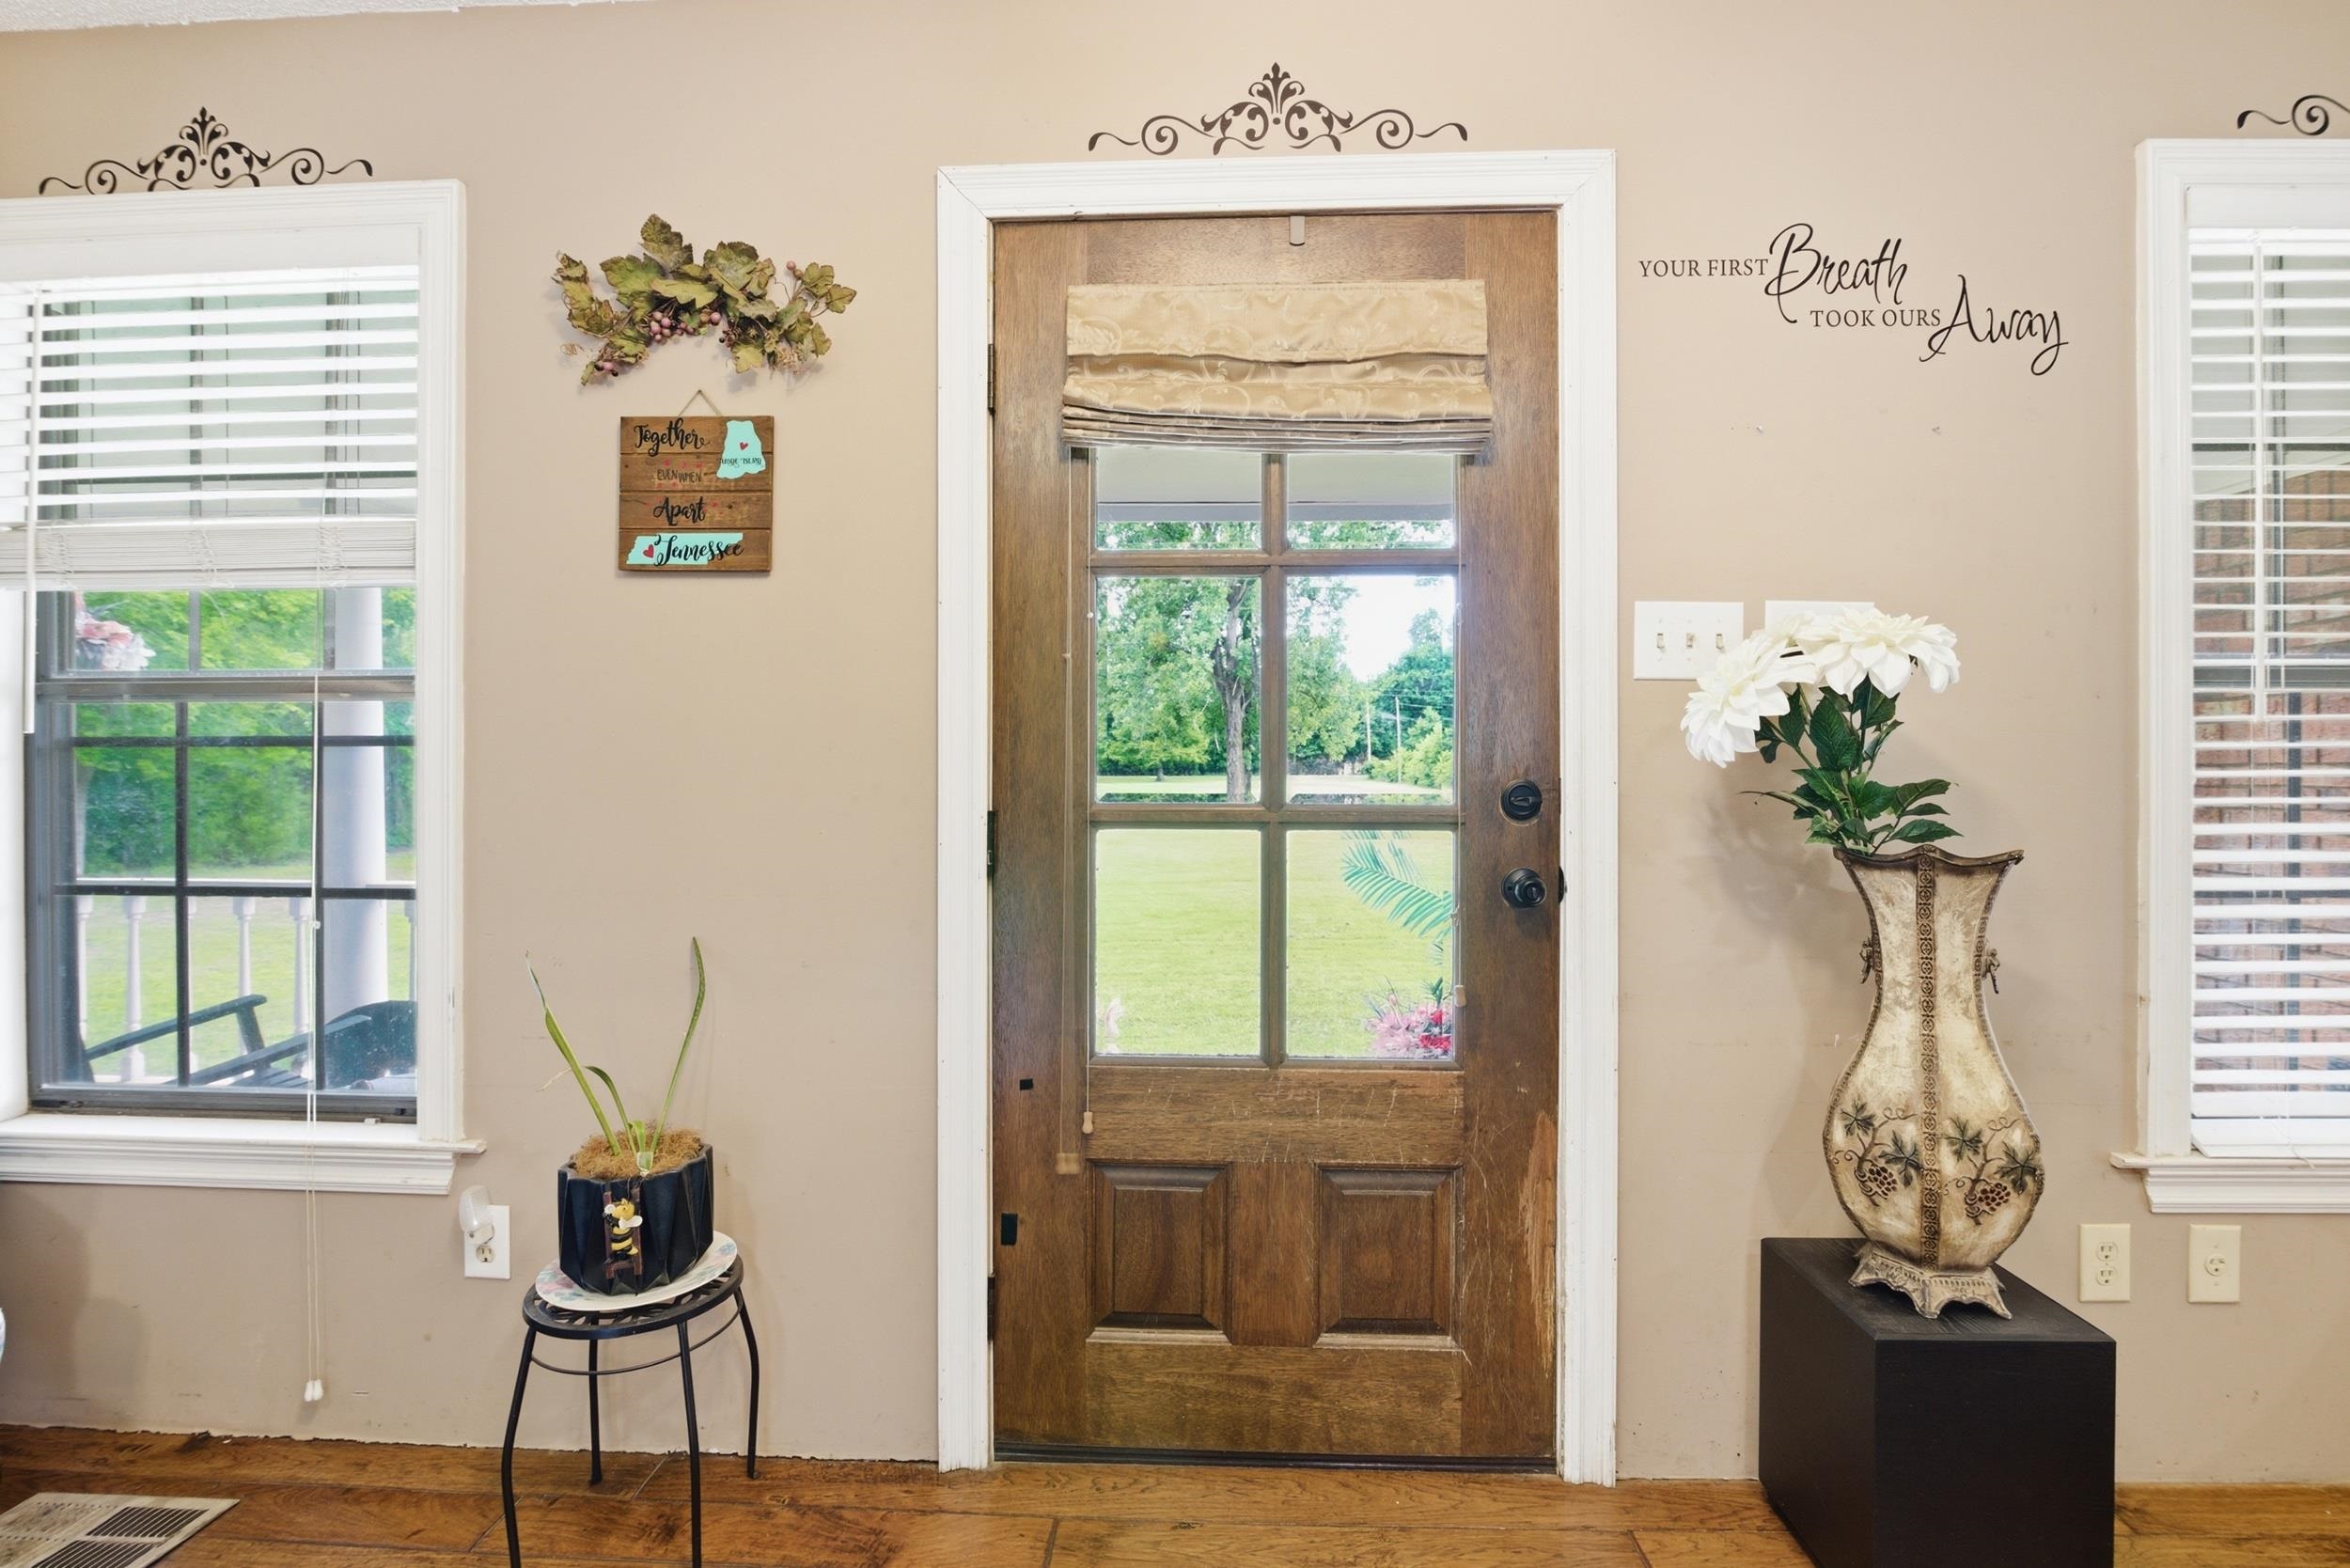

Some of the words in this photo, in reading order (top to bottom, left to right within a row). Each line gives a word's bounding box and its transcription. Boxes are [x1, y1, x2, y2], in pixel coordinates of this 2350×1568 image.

[1639, 259, 1702, 277] YOUR
[1707, 259, 1769, 276] FIRST
[1764, 223, 1908, 324] Breath
[1810, 308, 1875, 327] TOOK
[1882, 308, 1941, 327] OURS
[1919, 274, 2069, 376] Away
[633, 417, 711, 458] Together
[657, 468, 678, 481] EVEN
[678, 471, 702, 483] WHEN
[652, 496, 706, 526] Apart
[653, 533, 744, 567] Tennessee
